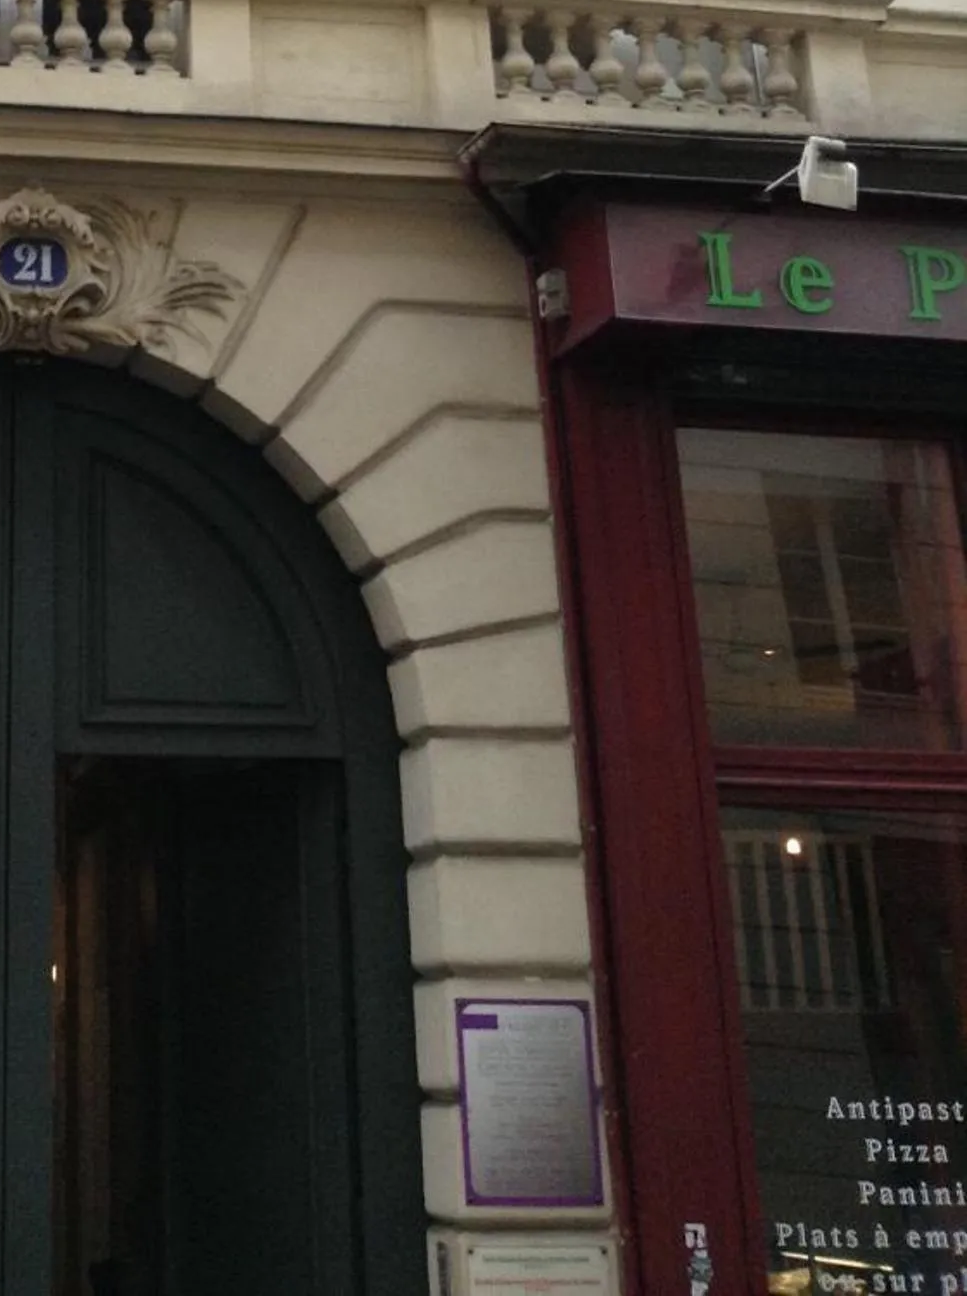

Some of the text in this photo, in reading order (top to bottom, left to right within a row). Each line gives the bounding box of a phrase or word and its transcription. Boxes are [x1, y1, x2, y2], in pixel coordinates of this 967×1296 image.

[13, 243, 53, 282] 21
[698, 229, 836, 315] Le
[865, 1137, 949, 1164] Pizza
[858, 1180, 967, 1206] Panini
[775, 1222, 860, 1249] Plats
[873, 1222, 891, 1249] à
[872, 1272, 925, 1293] sur
